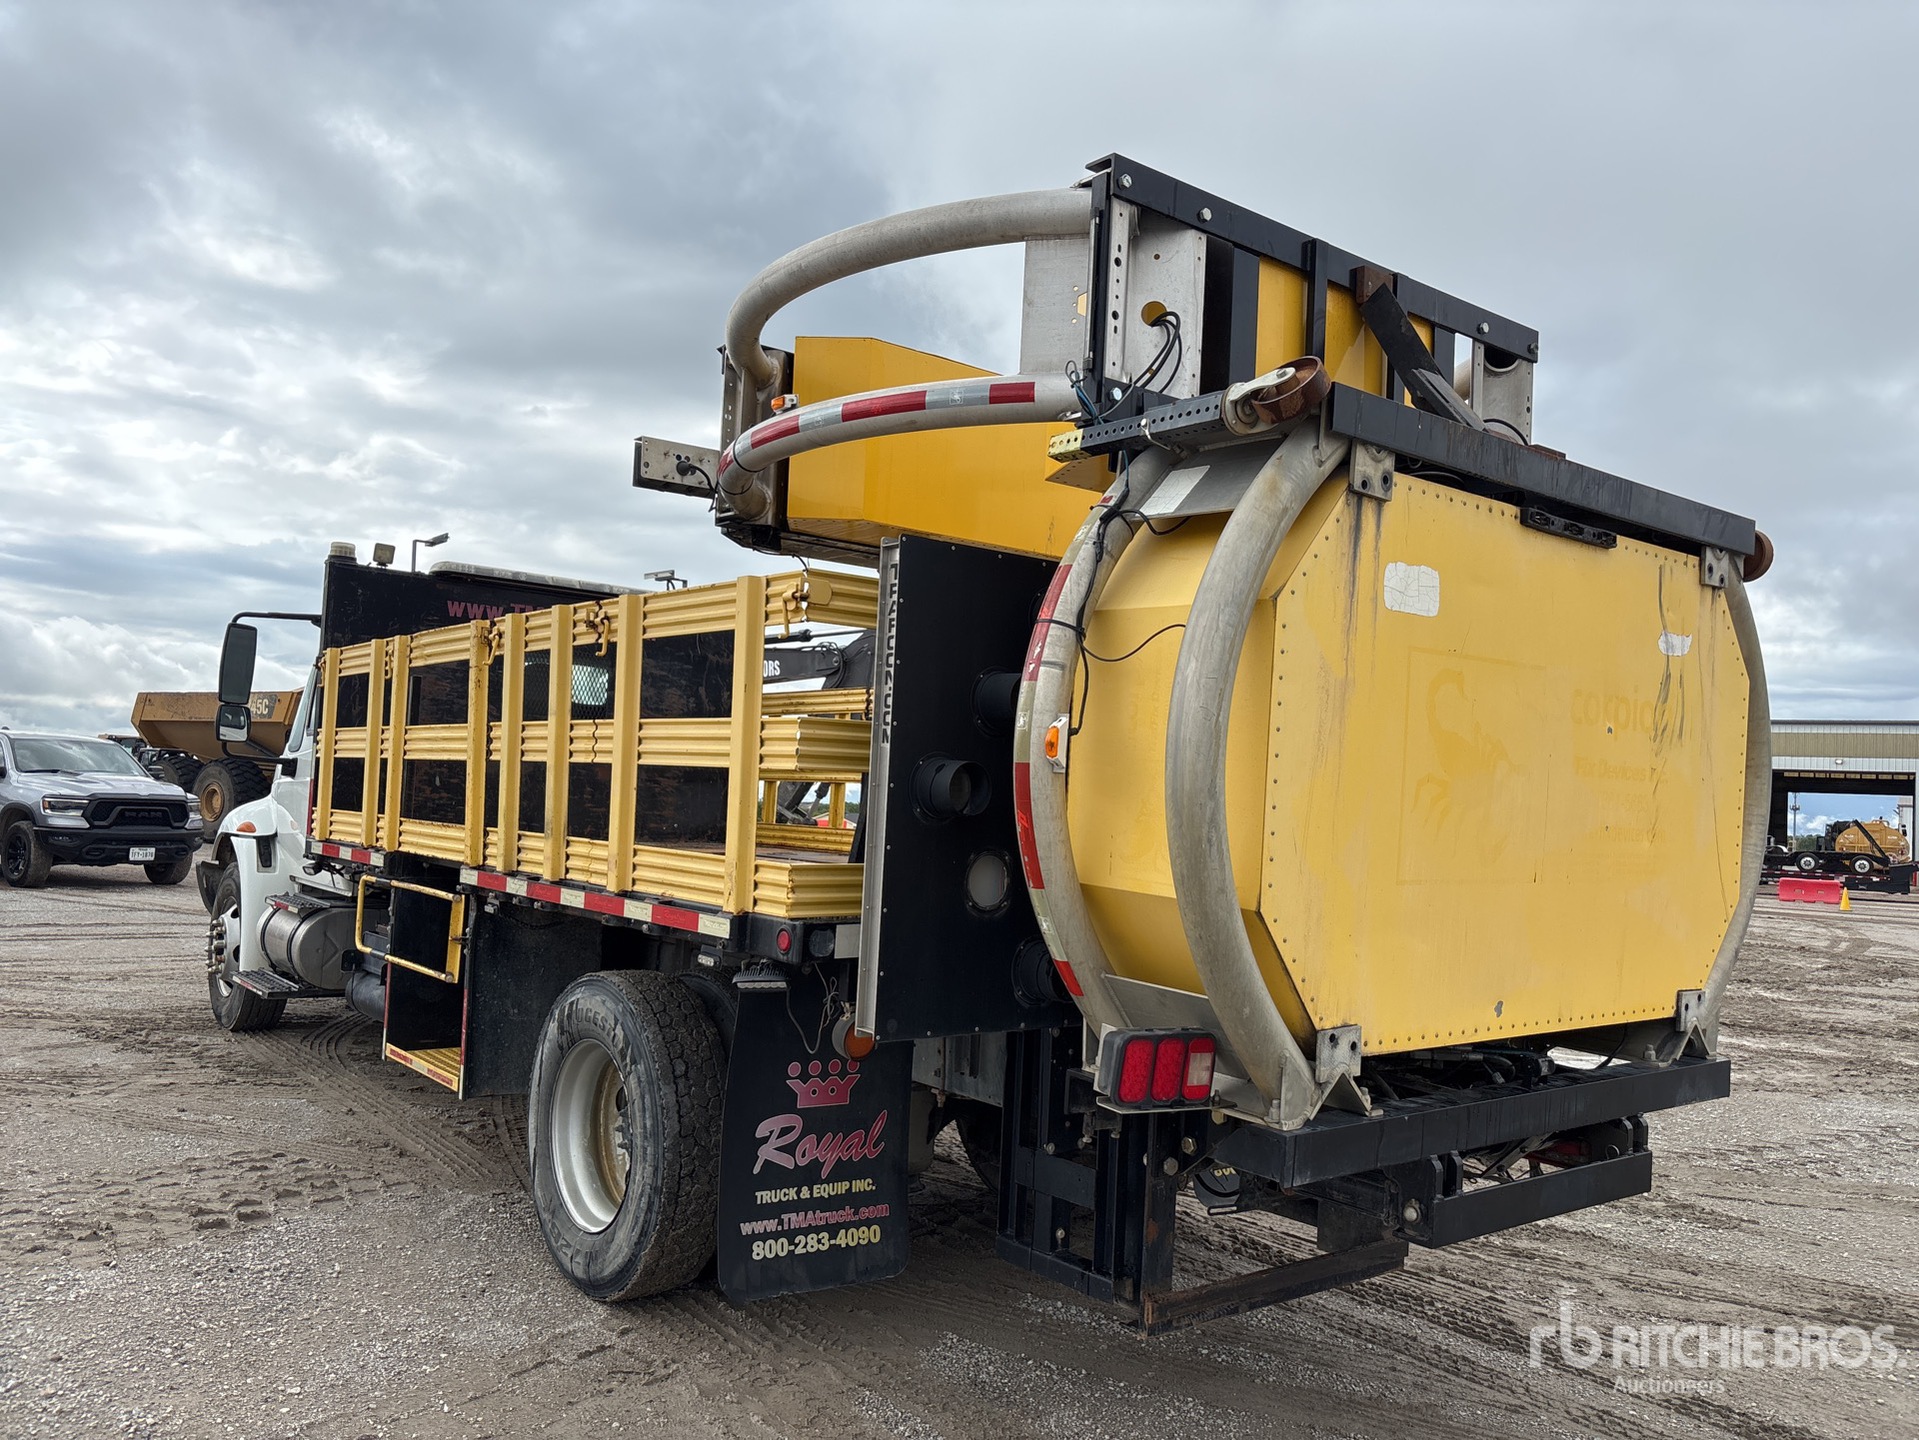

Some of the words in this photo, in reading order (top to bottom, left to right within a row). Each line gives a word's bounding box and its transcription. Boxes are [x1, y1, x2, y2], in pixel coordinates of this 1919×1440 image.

[250, 698, 269, 715] 45C
[752, 1110, 888, 1179] Royal
[755, 1186, 798, 1205] TRUCK
[799, 1187, 811, 1200] &
[812, 1181, 850, 1198] EQUIP
[851, 1178, 876, 1192] INC.
[740, 1203, 890, 1236] www.TMAtruck.com
[751, 1224, 881, 1261] 800-283-4090
